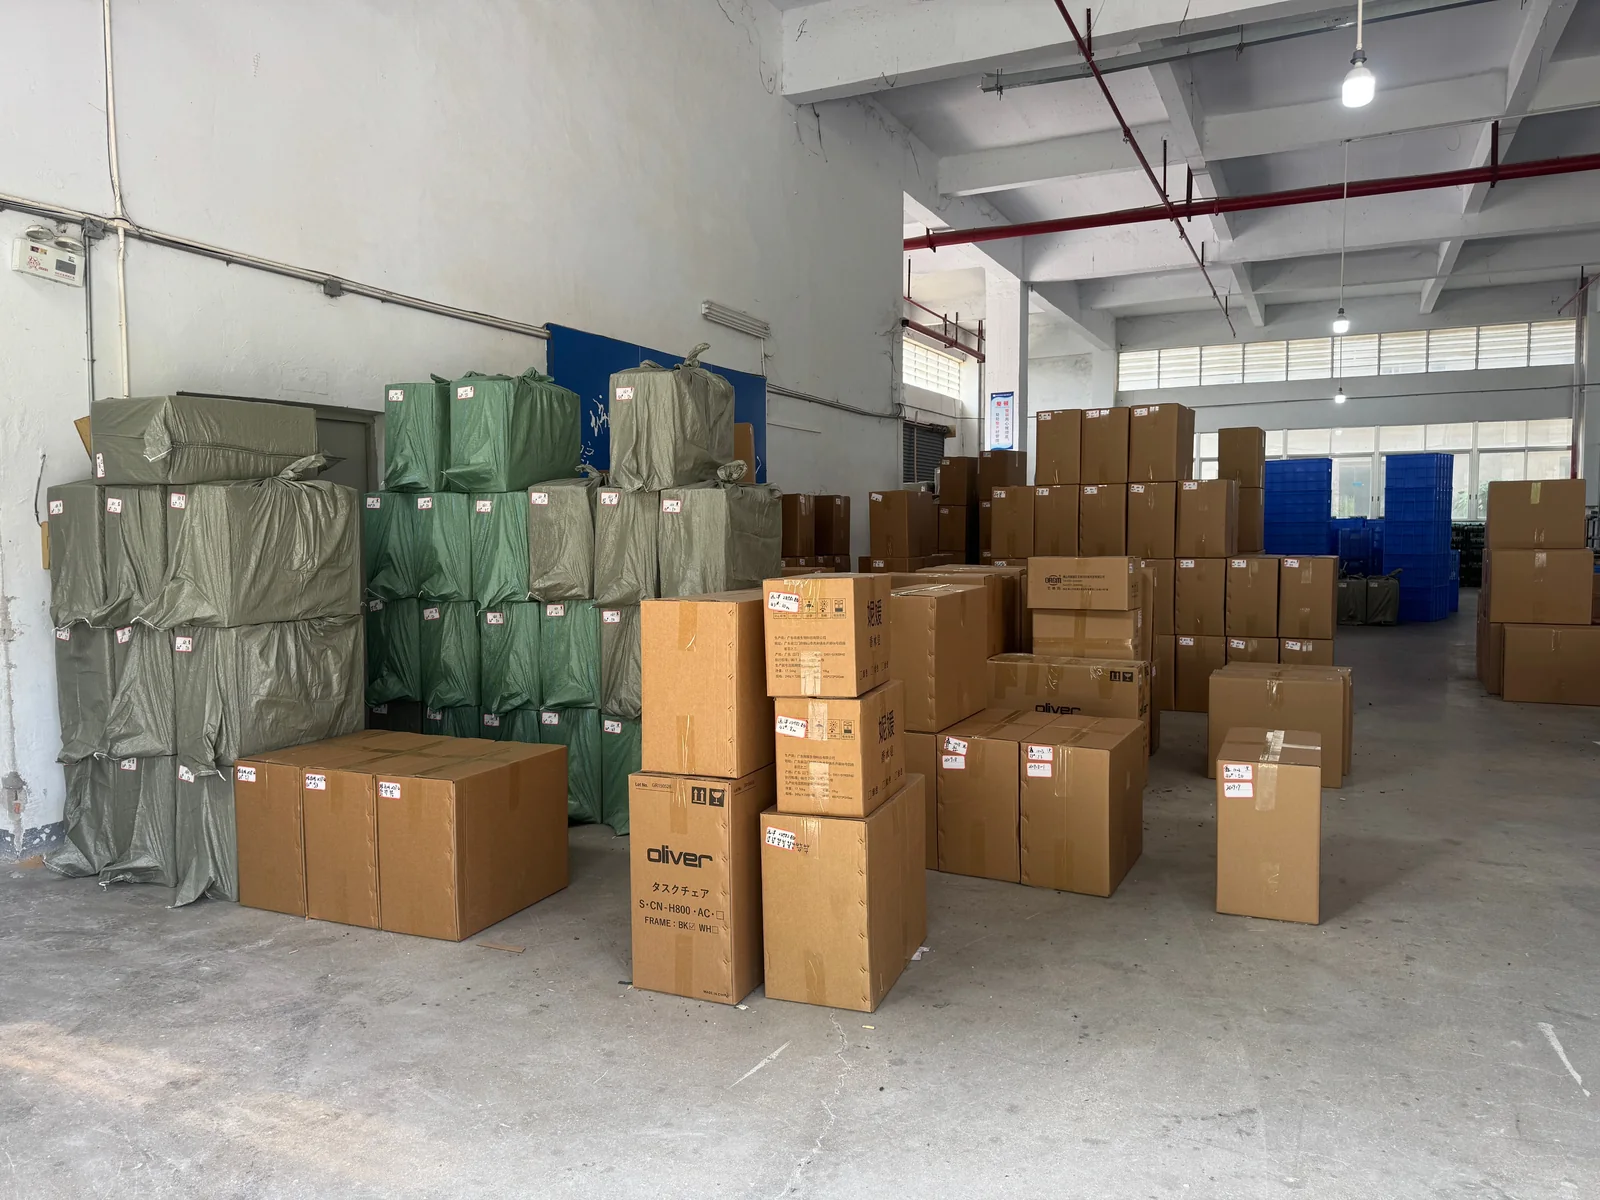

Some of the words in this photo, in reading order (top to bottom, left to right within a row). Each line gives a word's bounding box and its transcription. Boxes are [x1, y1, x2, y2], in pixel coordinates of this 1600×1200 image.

[1035, 702, 1081, 715] oliver
[647, 844, 713, 868] oliver
[652, 882, 710, 899] タスクチェア
